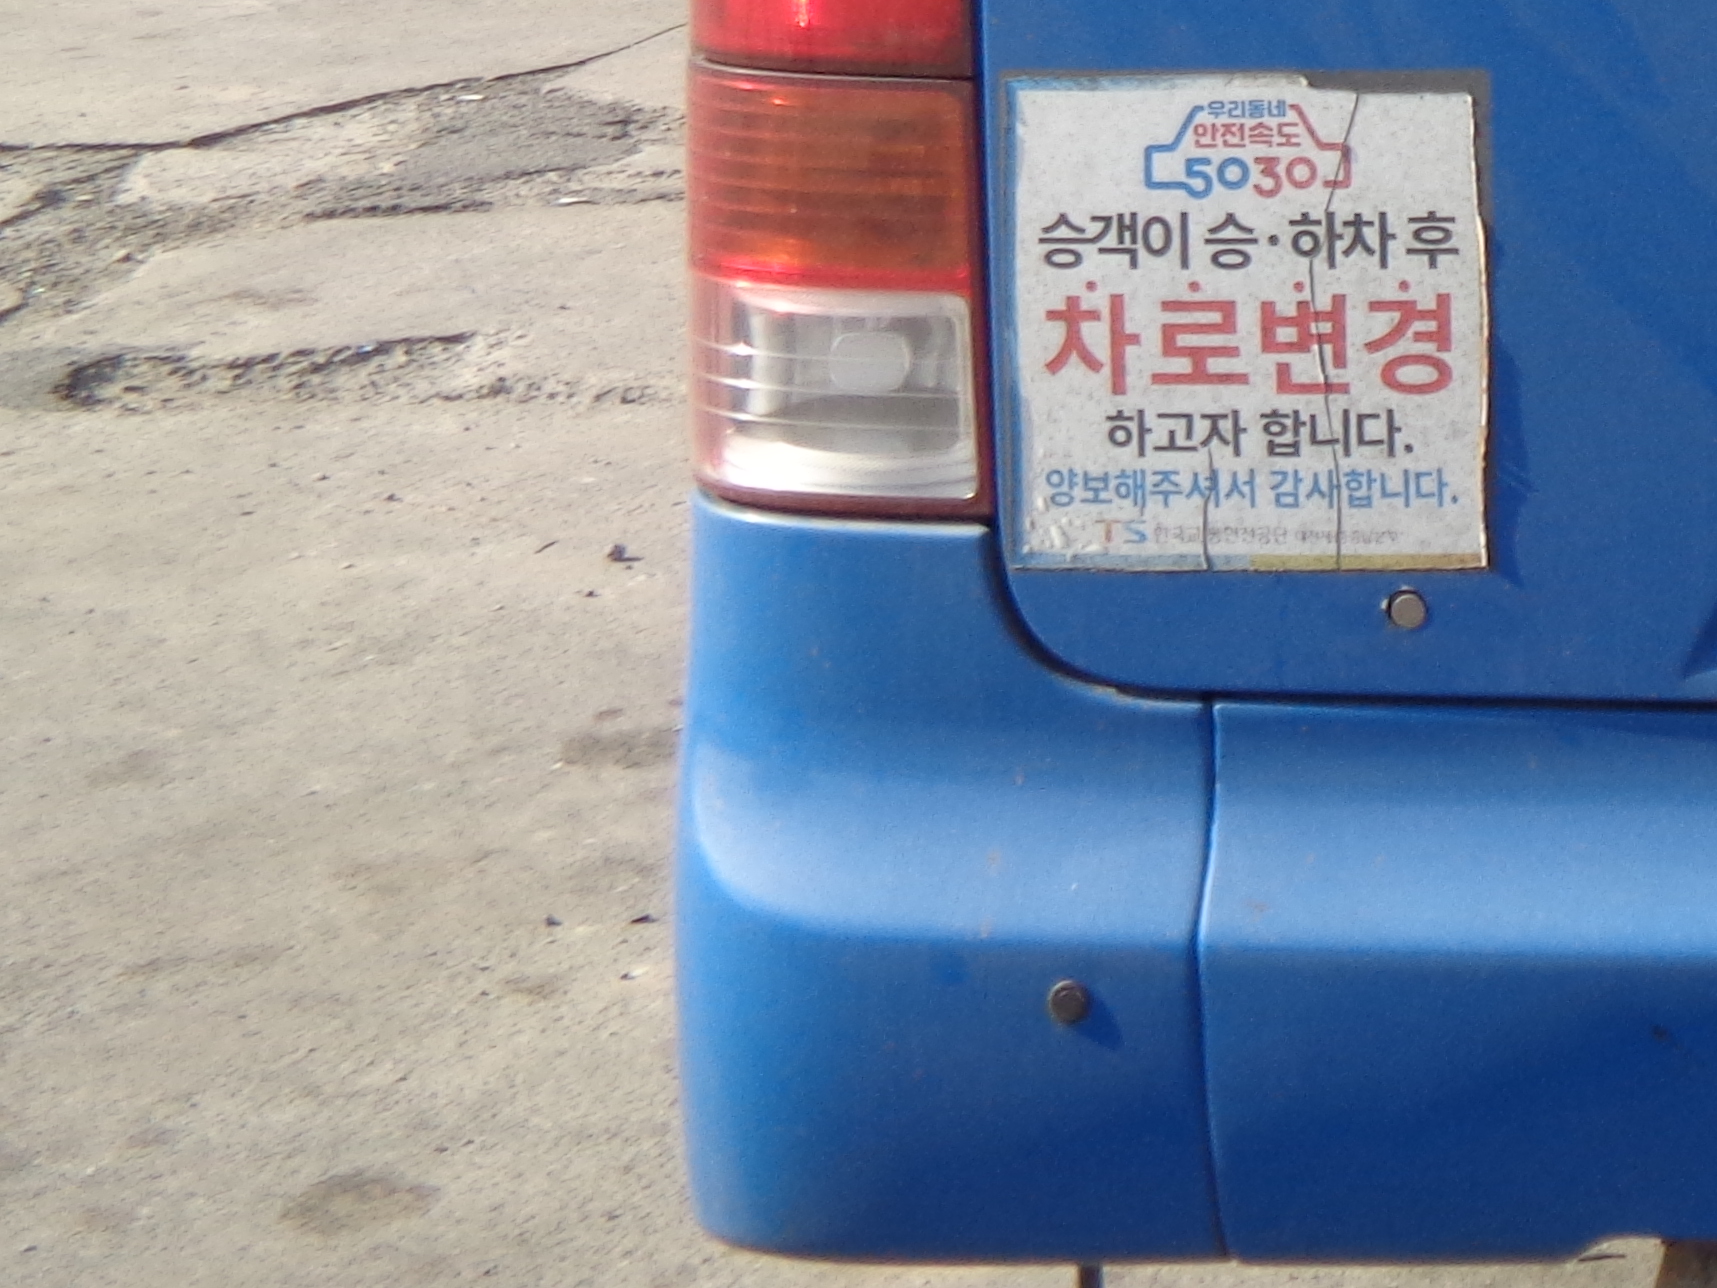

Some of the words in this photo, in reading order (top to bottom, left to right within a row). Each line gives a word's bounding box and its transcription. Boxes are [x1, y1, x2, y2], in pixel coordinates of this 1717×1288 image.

[1207, 100, 1287, 118] 우리동네
[1193, 122, 1301, 148] 안전속도
[1185, 156, 1318, 199] 5030
[1038, 212, 1190, 270] 승객이
[1405, 211, 1459, 270] 후
[1043, 291, 1455, 397] 차로변경
[1106, 409, 1247, 457] 하고자
[1260, 409, 1414, 457] 합니다.
[1045, 467, 1257, 510] 양보해주셔서
[1268, 469, 1460, 509] 감사합니다.
